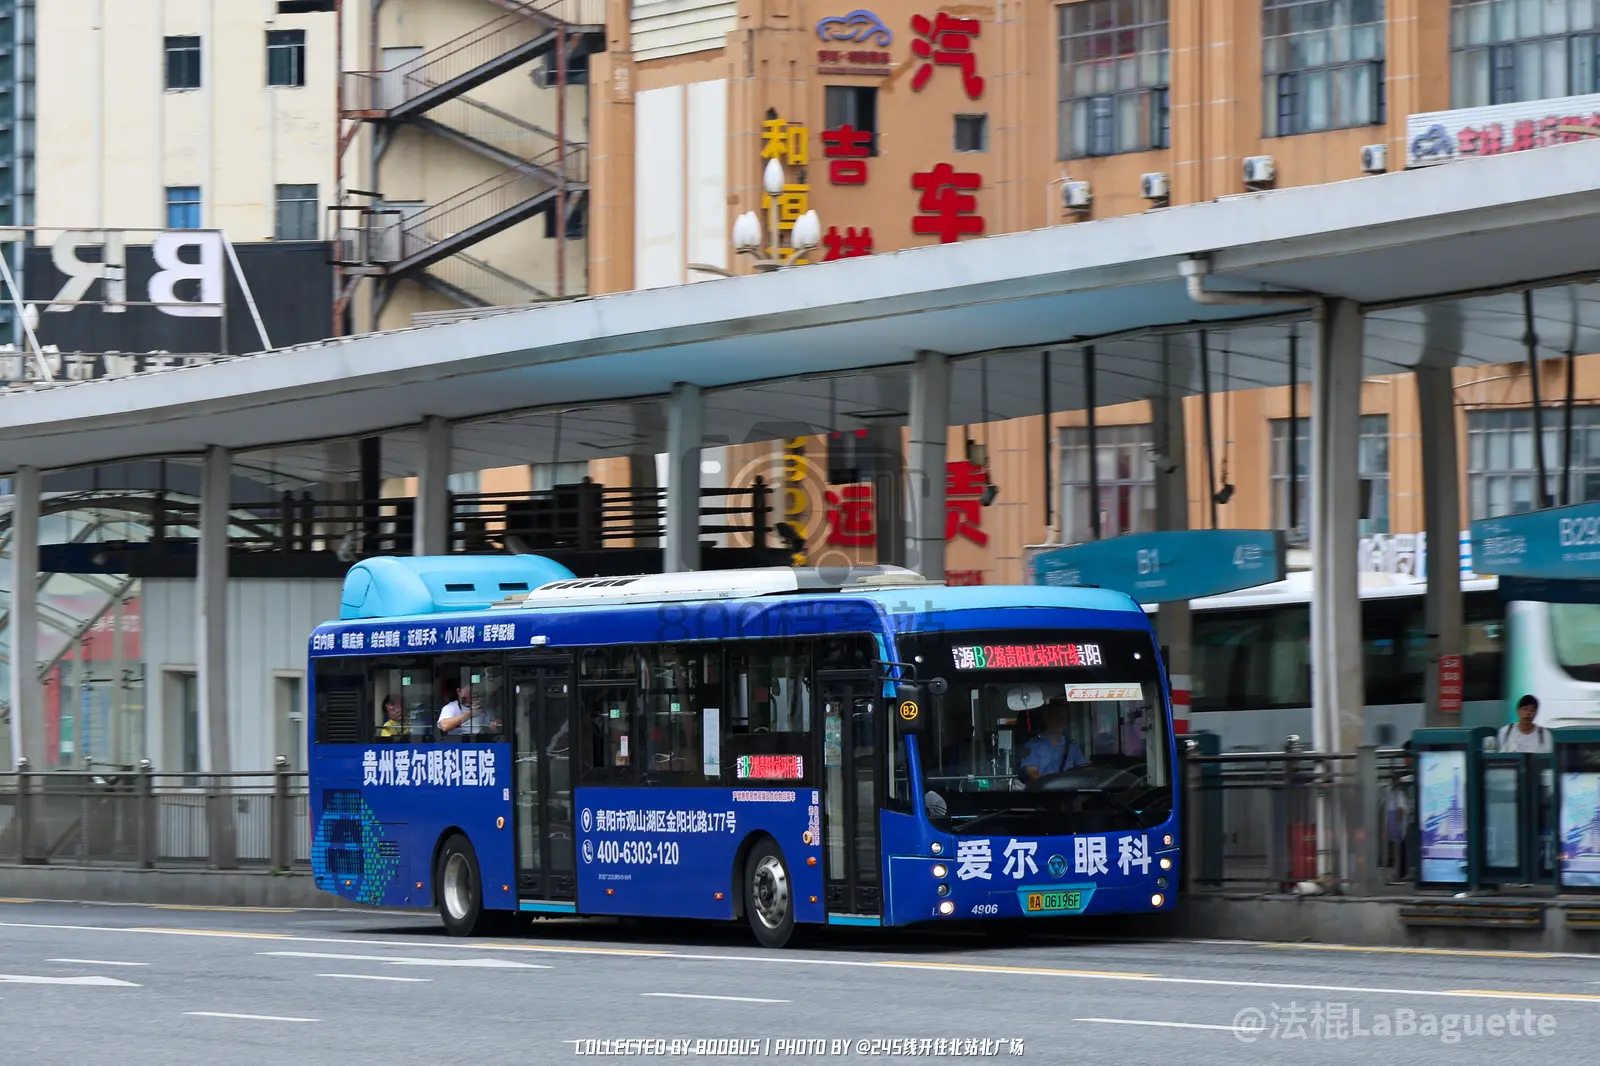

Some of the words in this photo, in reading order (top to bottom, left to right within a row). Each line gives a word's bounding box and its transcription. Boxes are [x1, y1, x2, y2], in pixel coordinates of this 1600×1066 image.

[1559, 516, 1600, 547] B29
[313, 632, 336, 651] 白内障
[407, 627, 438, 647] 近视手术
[444, 625, 476, 645] 小儿眼科
[483, 622, 516, 642] 医学配镜
[362, 749, 496, 787] 贵州爱尔眼科医院
[596, 809, 737, 834] 贵阳市观山湖区金阳北路177号
[597, 841, 680, 866] 400-6303-120
[956, 838, 1039, 881] 爱尔
[1073, 834, 1152, 876] 眼科
[971, 903, 999, 915] 4906
